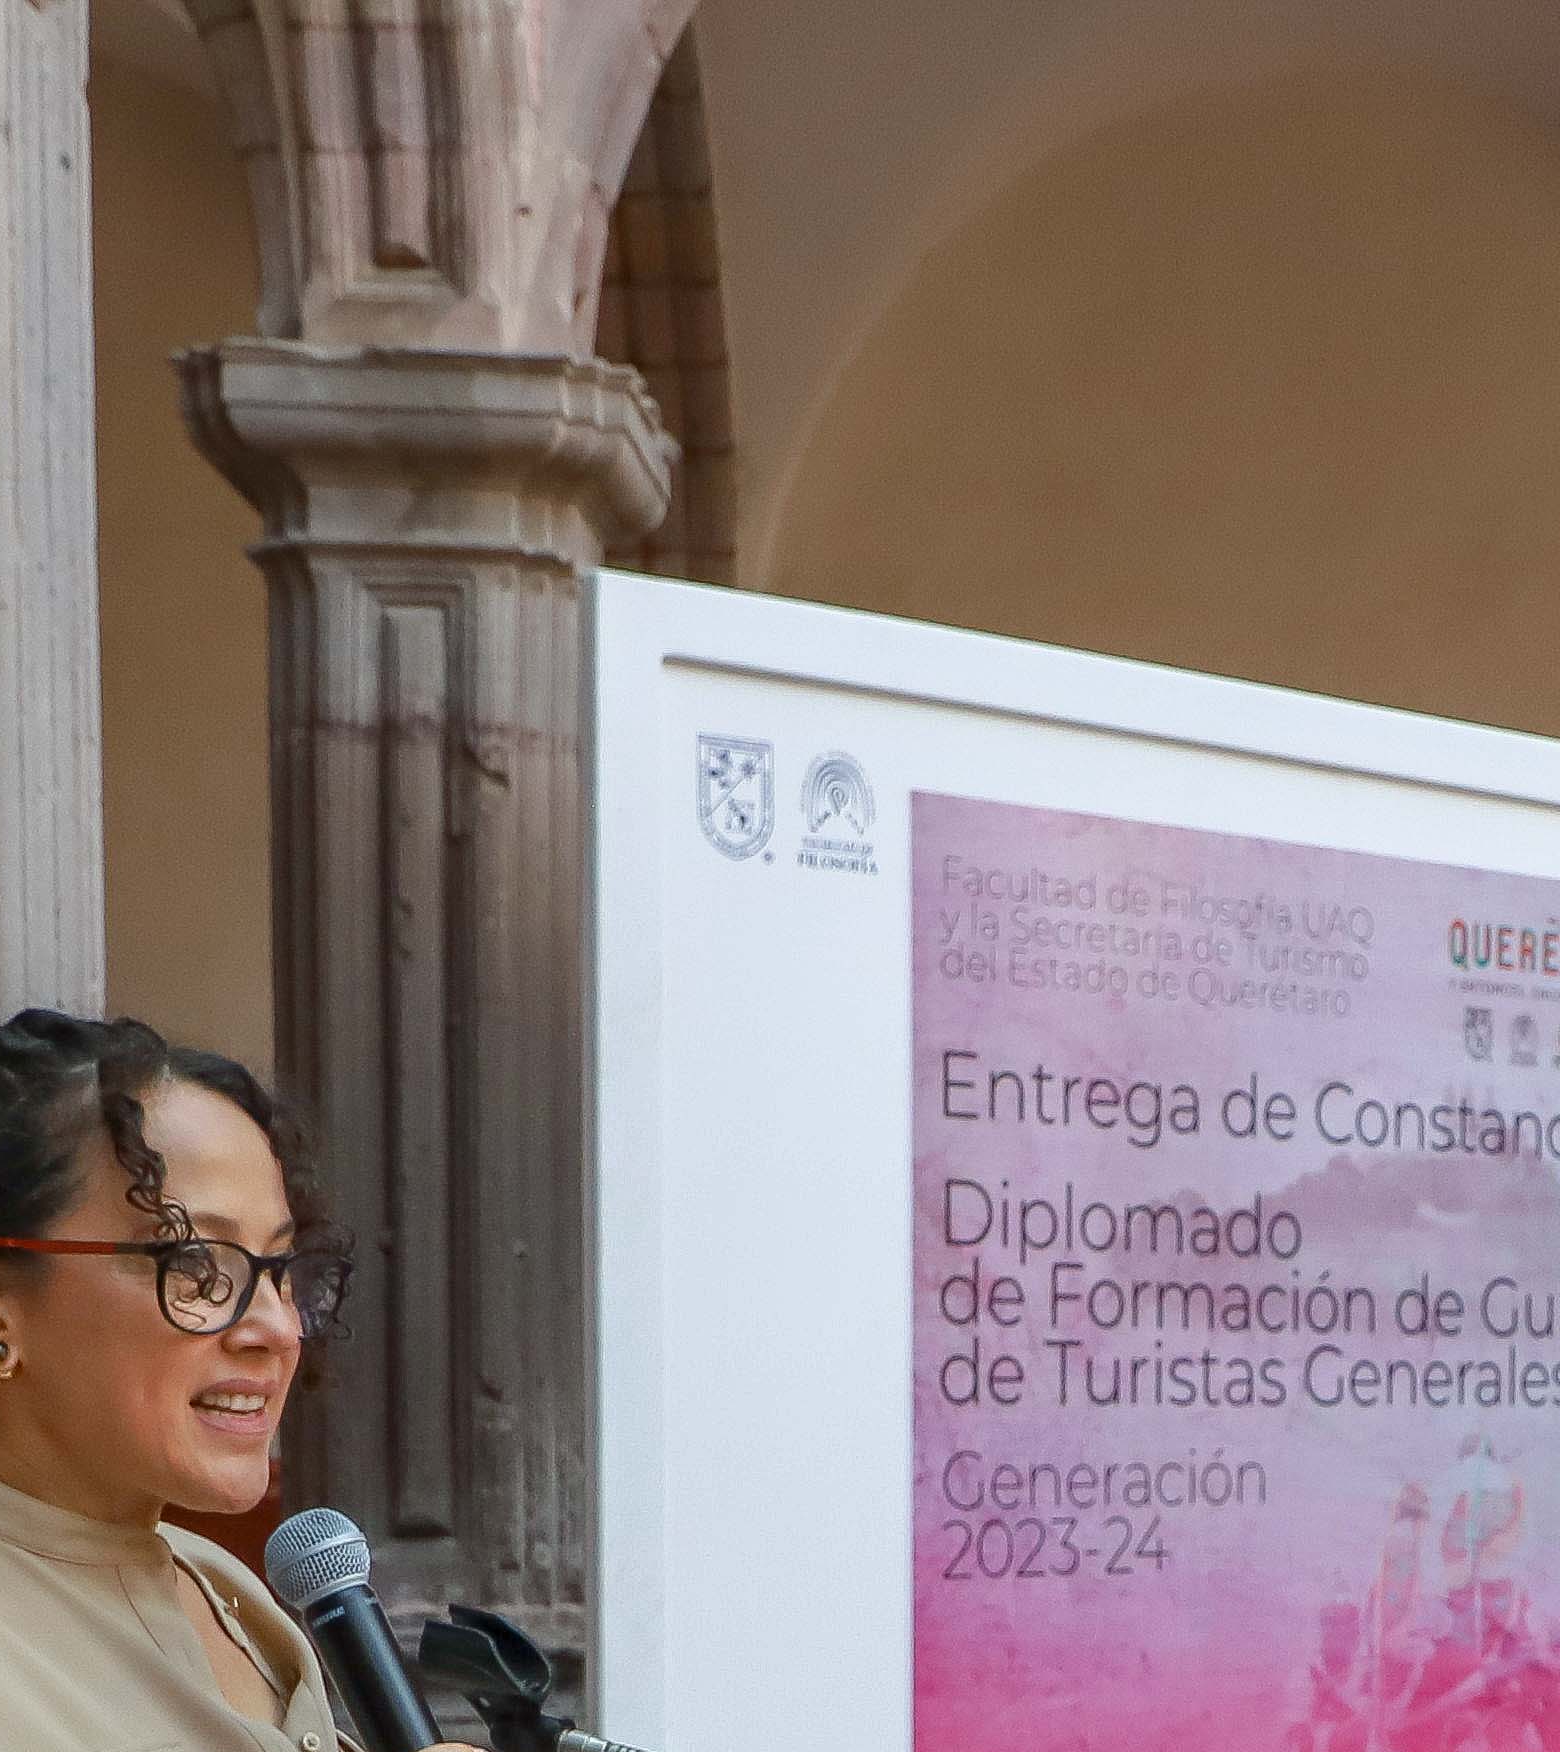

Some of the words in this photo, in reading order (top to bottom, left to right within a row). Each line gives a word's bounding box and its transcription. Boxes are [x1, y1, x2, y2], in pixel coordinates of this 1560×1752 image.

[942, 854, 1097, 911] Facultad
[1106, 876, 1149, 916] de
[1302, 902, 1376, 948] UAQ
[938, 907, 961, 944] y
[971, 903, 1000, 940] la
[1191, 929, 1233, 966] de
[1243, 934, 1370, 982] Turismo
[939, 944, 996, 983] del
[1007, 946, 1129, 996] Estado
[1136, 962, 1181, 1001] de
[942, 1049, 1201, 1149] Entrega
[1221, 1072, 1297, 1141] de
[943, 1178, 1303, 1264] Diplomado
[939, 1258, 1026, 1328] de
[1050, 1262, 1377, 1337] Formación
[1393, 1271, 1465, 1338] de
[939, 1338, 1026, 1407] de
[1046, 1340, 1288, 1408] Turistas
[941, 1448, 1268, 1514] Generación
[941, 1513, 1170, 1582] 2023-24
